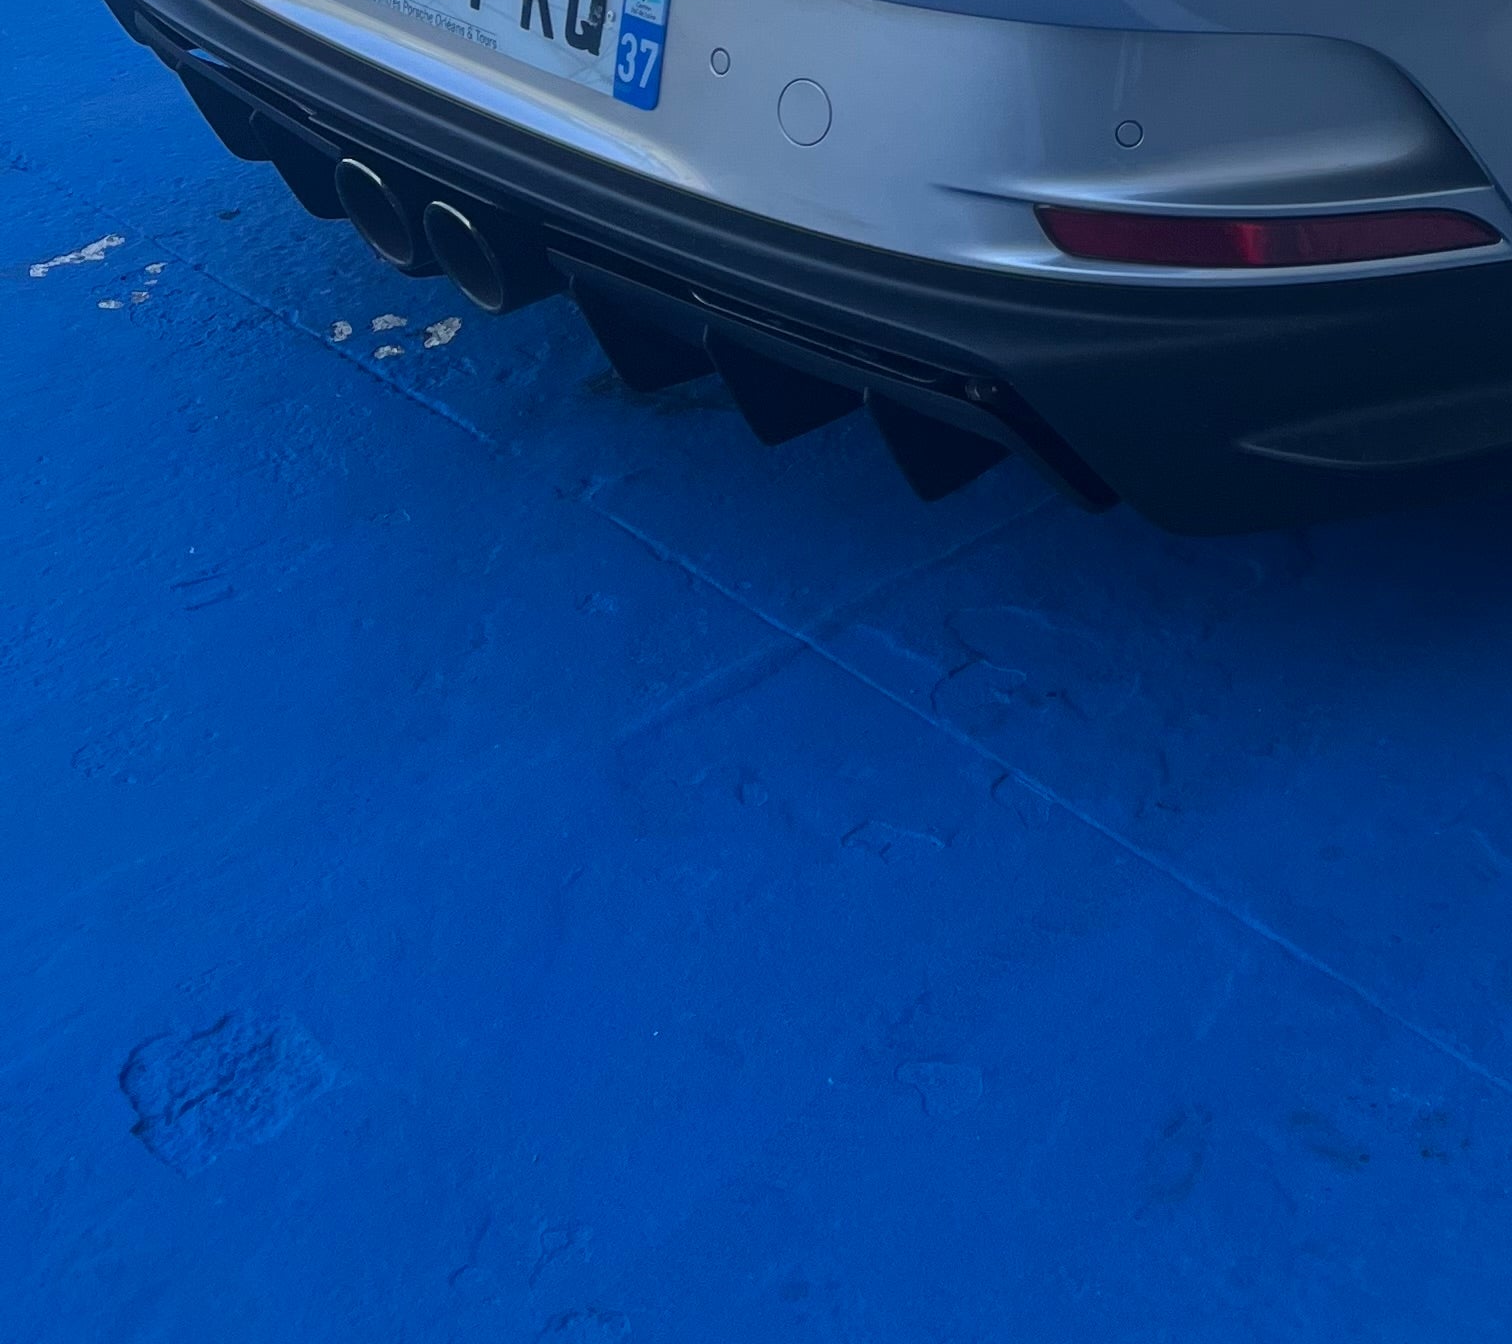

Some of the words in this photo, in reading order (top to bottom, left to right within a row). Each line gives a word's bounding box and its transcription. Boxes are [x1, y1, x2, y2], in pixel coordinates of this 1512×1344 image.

[402, 0, 434, 25] Porsche
[466, 25, 473, 40] &
[475, 29, 497, 50] Tours
[617, 31, 659, 89] 37
